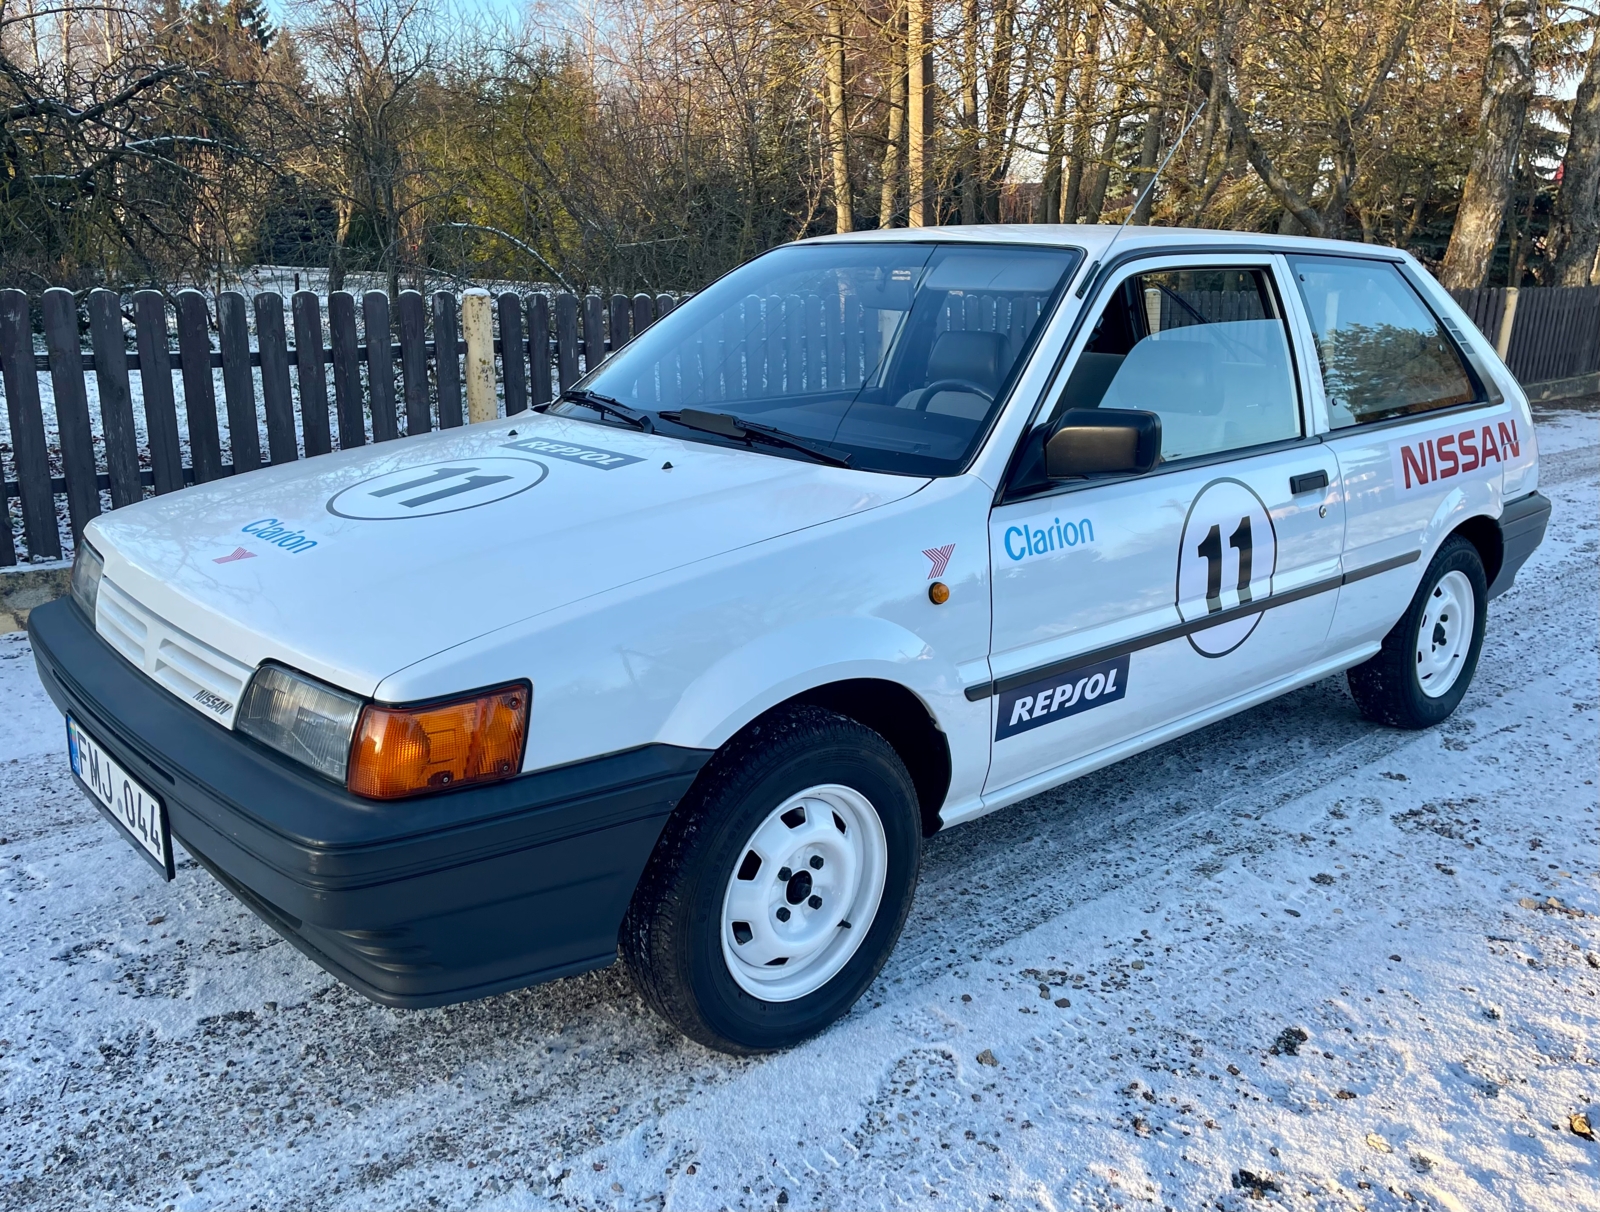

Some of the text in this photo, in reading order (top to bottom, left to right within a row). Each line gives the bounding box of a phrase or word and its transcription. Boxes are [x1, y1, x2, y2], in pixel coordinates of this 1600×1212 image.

[517, 440, 625, 466] REPSOL
[1400, 419, 1520, 490] NISSAN
[368, 467, 515, 508] 11
[241, 518, 318, 554] Clarion
[1004, 517, 1095, 561] Clarion
[1198, 515, 1253, 614] 11
[192, 689, 233, 715] NISSAN
[1009, 668, 1118, 727] REPSOL
[123, 779, 161, 856] 044
